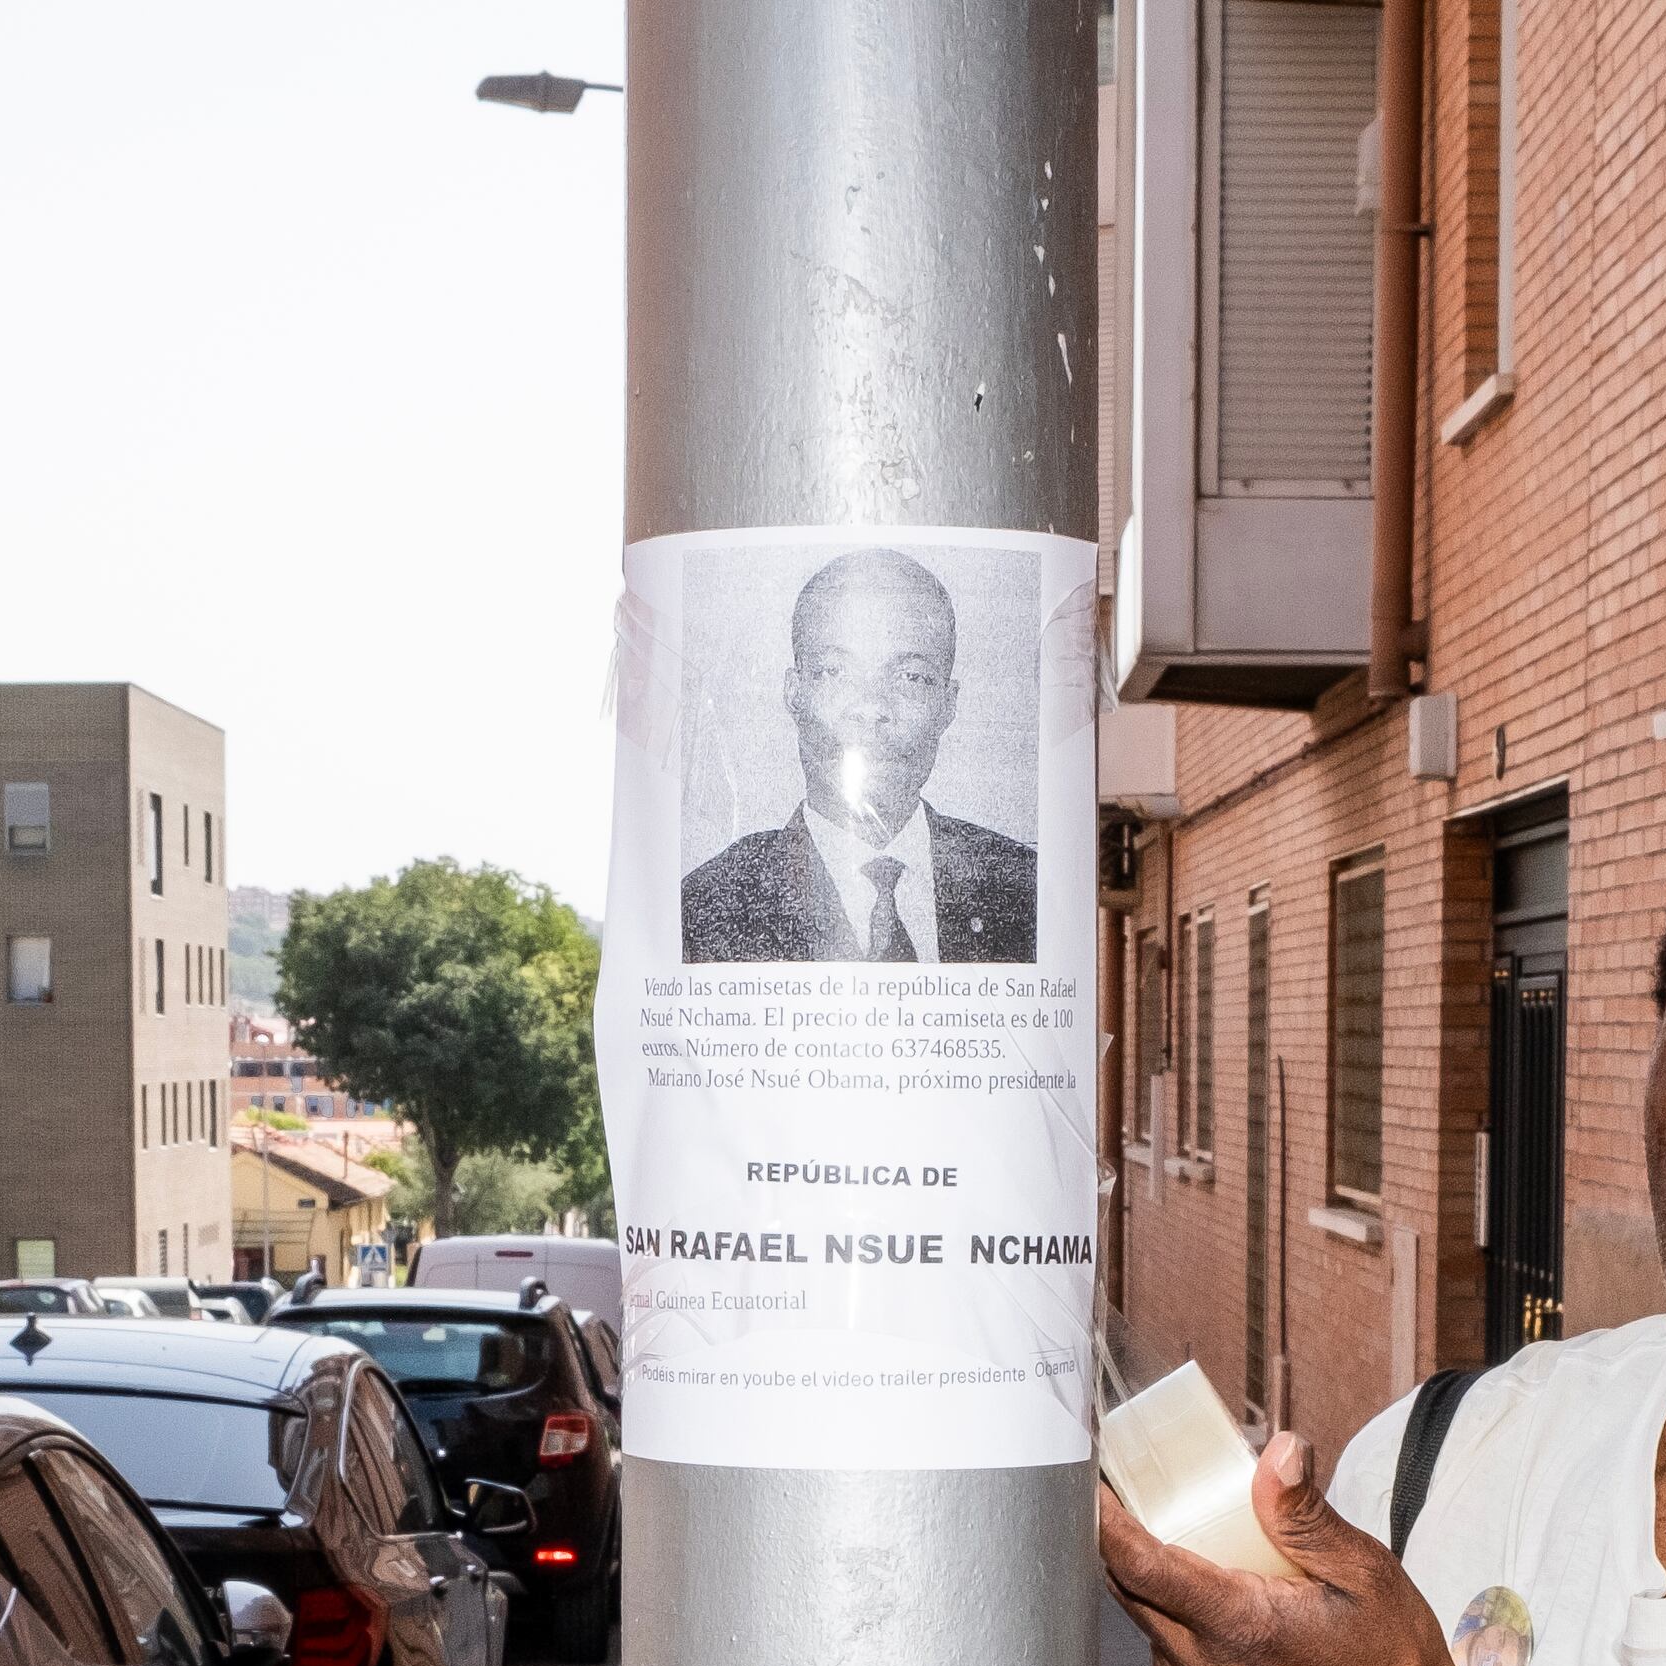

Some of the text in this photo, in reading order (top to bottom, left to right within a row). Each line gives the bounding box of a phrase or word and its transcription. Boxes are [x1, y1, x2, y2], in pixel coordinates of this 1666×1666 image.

[645, 976, 1076, 1001] Vendo las camisetas de la república de San Rafael
[640, 1007, 1073, 1032] Nsué Nchama. El precio de la camiseta es de 100
[642, 1037, 1005, 1058] euros. Número de contacto 637468535.
[648, 1068, 1076, 1094] Mariano José Nsué Obama, próximo presidente la
[748, 1160, 957, 1186] REPÚBLICA DE
[626, 1226, 1091, 1264] SAN RAFAEL NSUE NCHAMA
[656, 1291, 704, 1310] Guinea
[712, 1290, 805, 1310] Ecuatorial
[679, 1369, 715, 1384] mirar
[720, 1373, 738, 1385] en
[802, 1371, 817, 1387] el
[823, 1371, 873, 1387] video
[880, 1370, 934, 1386] trailer
[940, 1368, 1025, 1388] presidente
[1035, 1358, 1074, 1378] Obama
